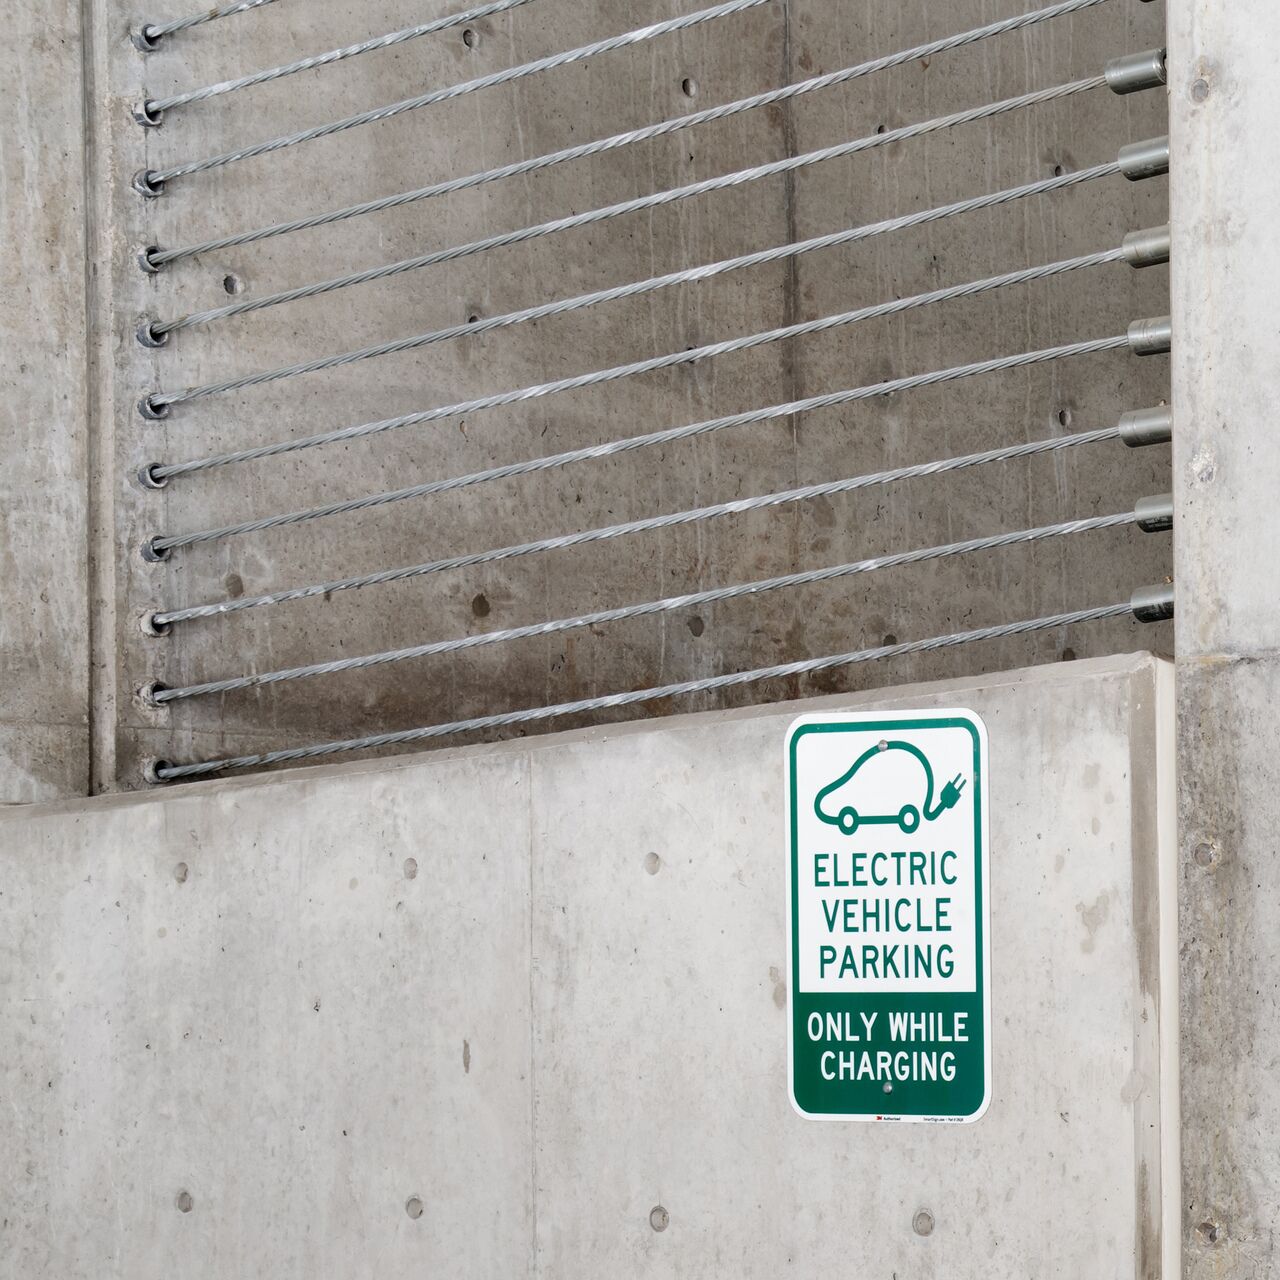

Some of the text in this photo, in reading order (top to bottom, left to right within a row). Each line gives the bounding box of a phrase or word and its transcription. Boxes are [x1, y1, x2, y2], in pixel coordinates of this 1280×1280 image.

[815, 851, 957, 887] ELECTRIC
[822, 898, 951, 932] VEHICLE
[820, 944, 954, 978] PARKING
[808, 1012, 968, 1041] ONLY WHILE
[821, 1051, 955, 1081] CHARGING
